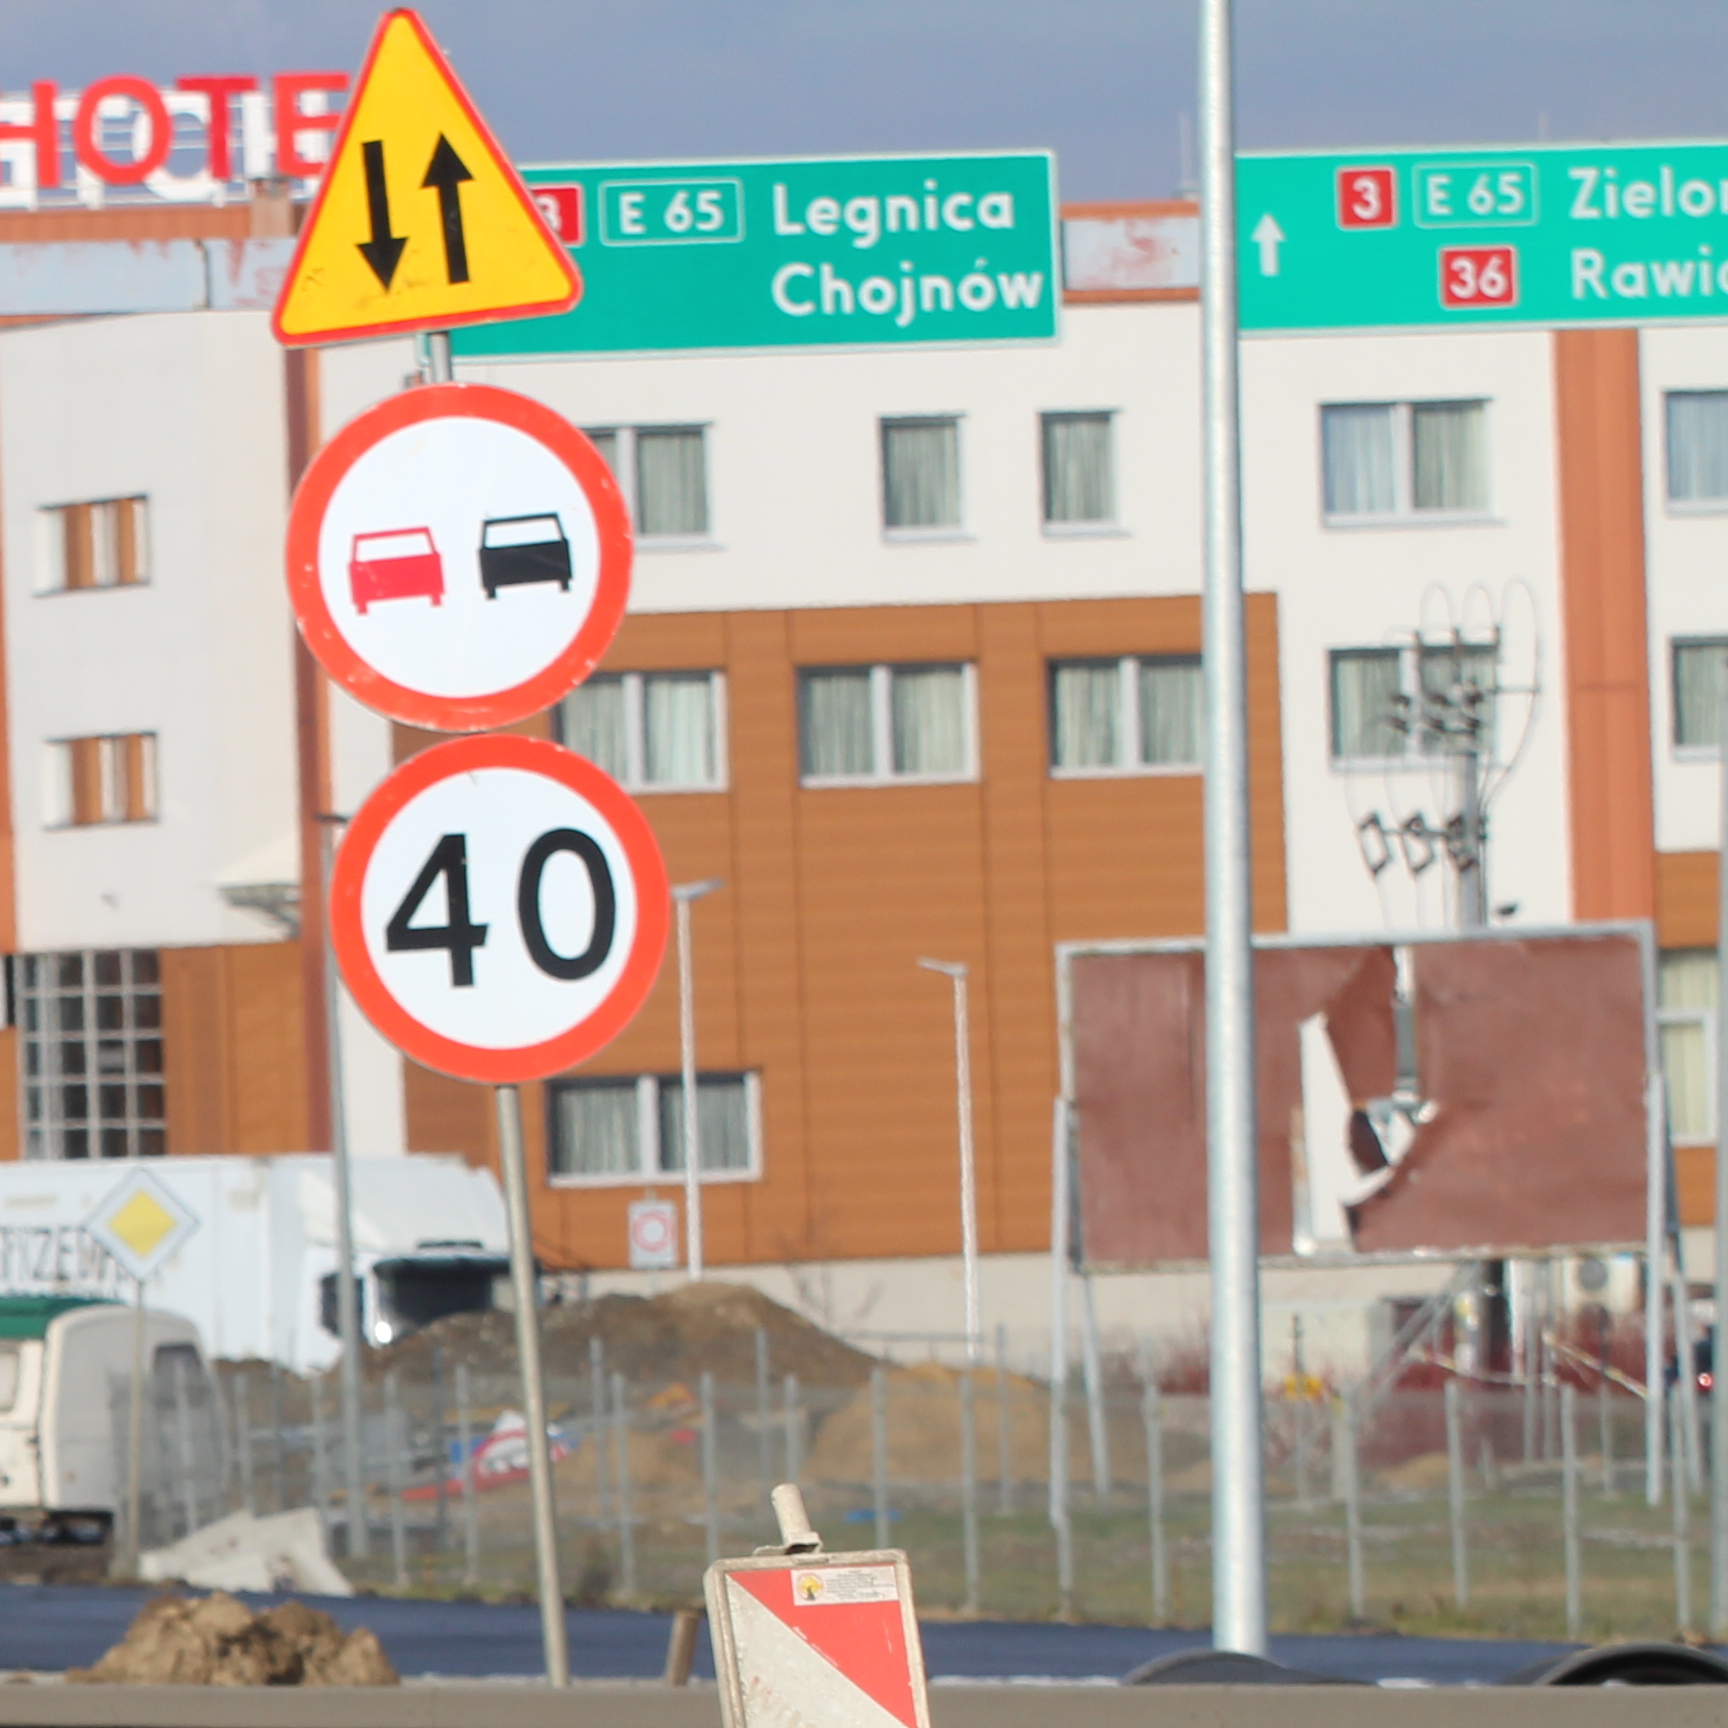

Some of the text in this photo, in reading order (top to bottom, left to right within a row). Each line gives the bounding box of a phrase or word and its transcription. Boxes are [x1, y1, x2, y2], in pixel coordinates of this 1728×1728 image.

[618, 189, 725, 235] E 65
[772, 177, 1016, 250] Legnica
[1351, 176, 1382, 221] 3
[1426, 172, 1525, 217] E 65
[1568, 163, 1728, 219] Zielo
[771, 255, 1046, 329] Chojnów
[1448, 255, 1508, 300] 36
[384, 826, 617, 989] 40
